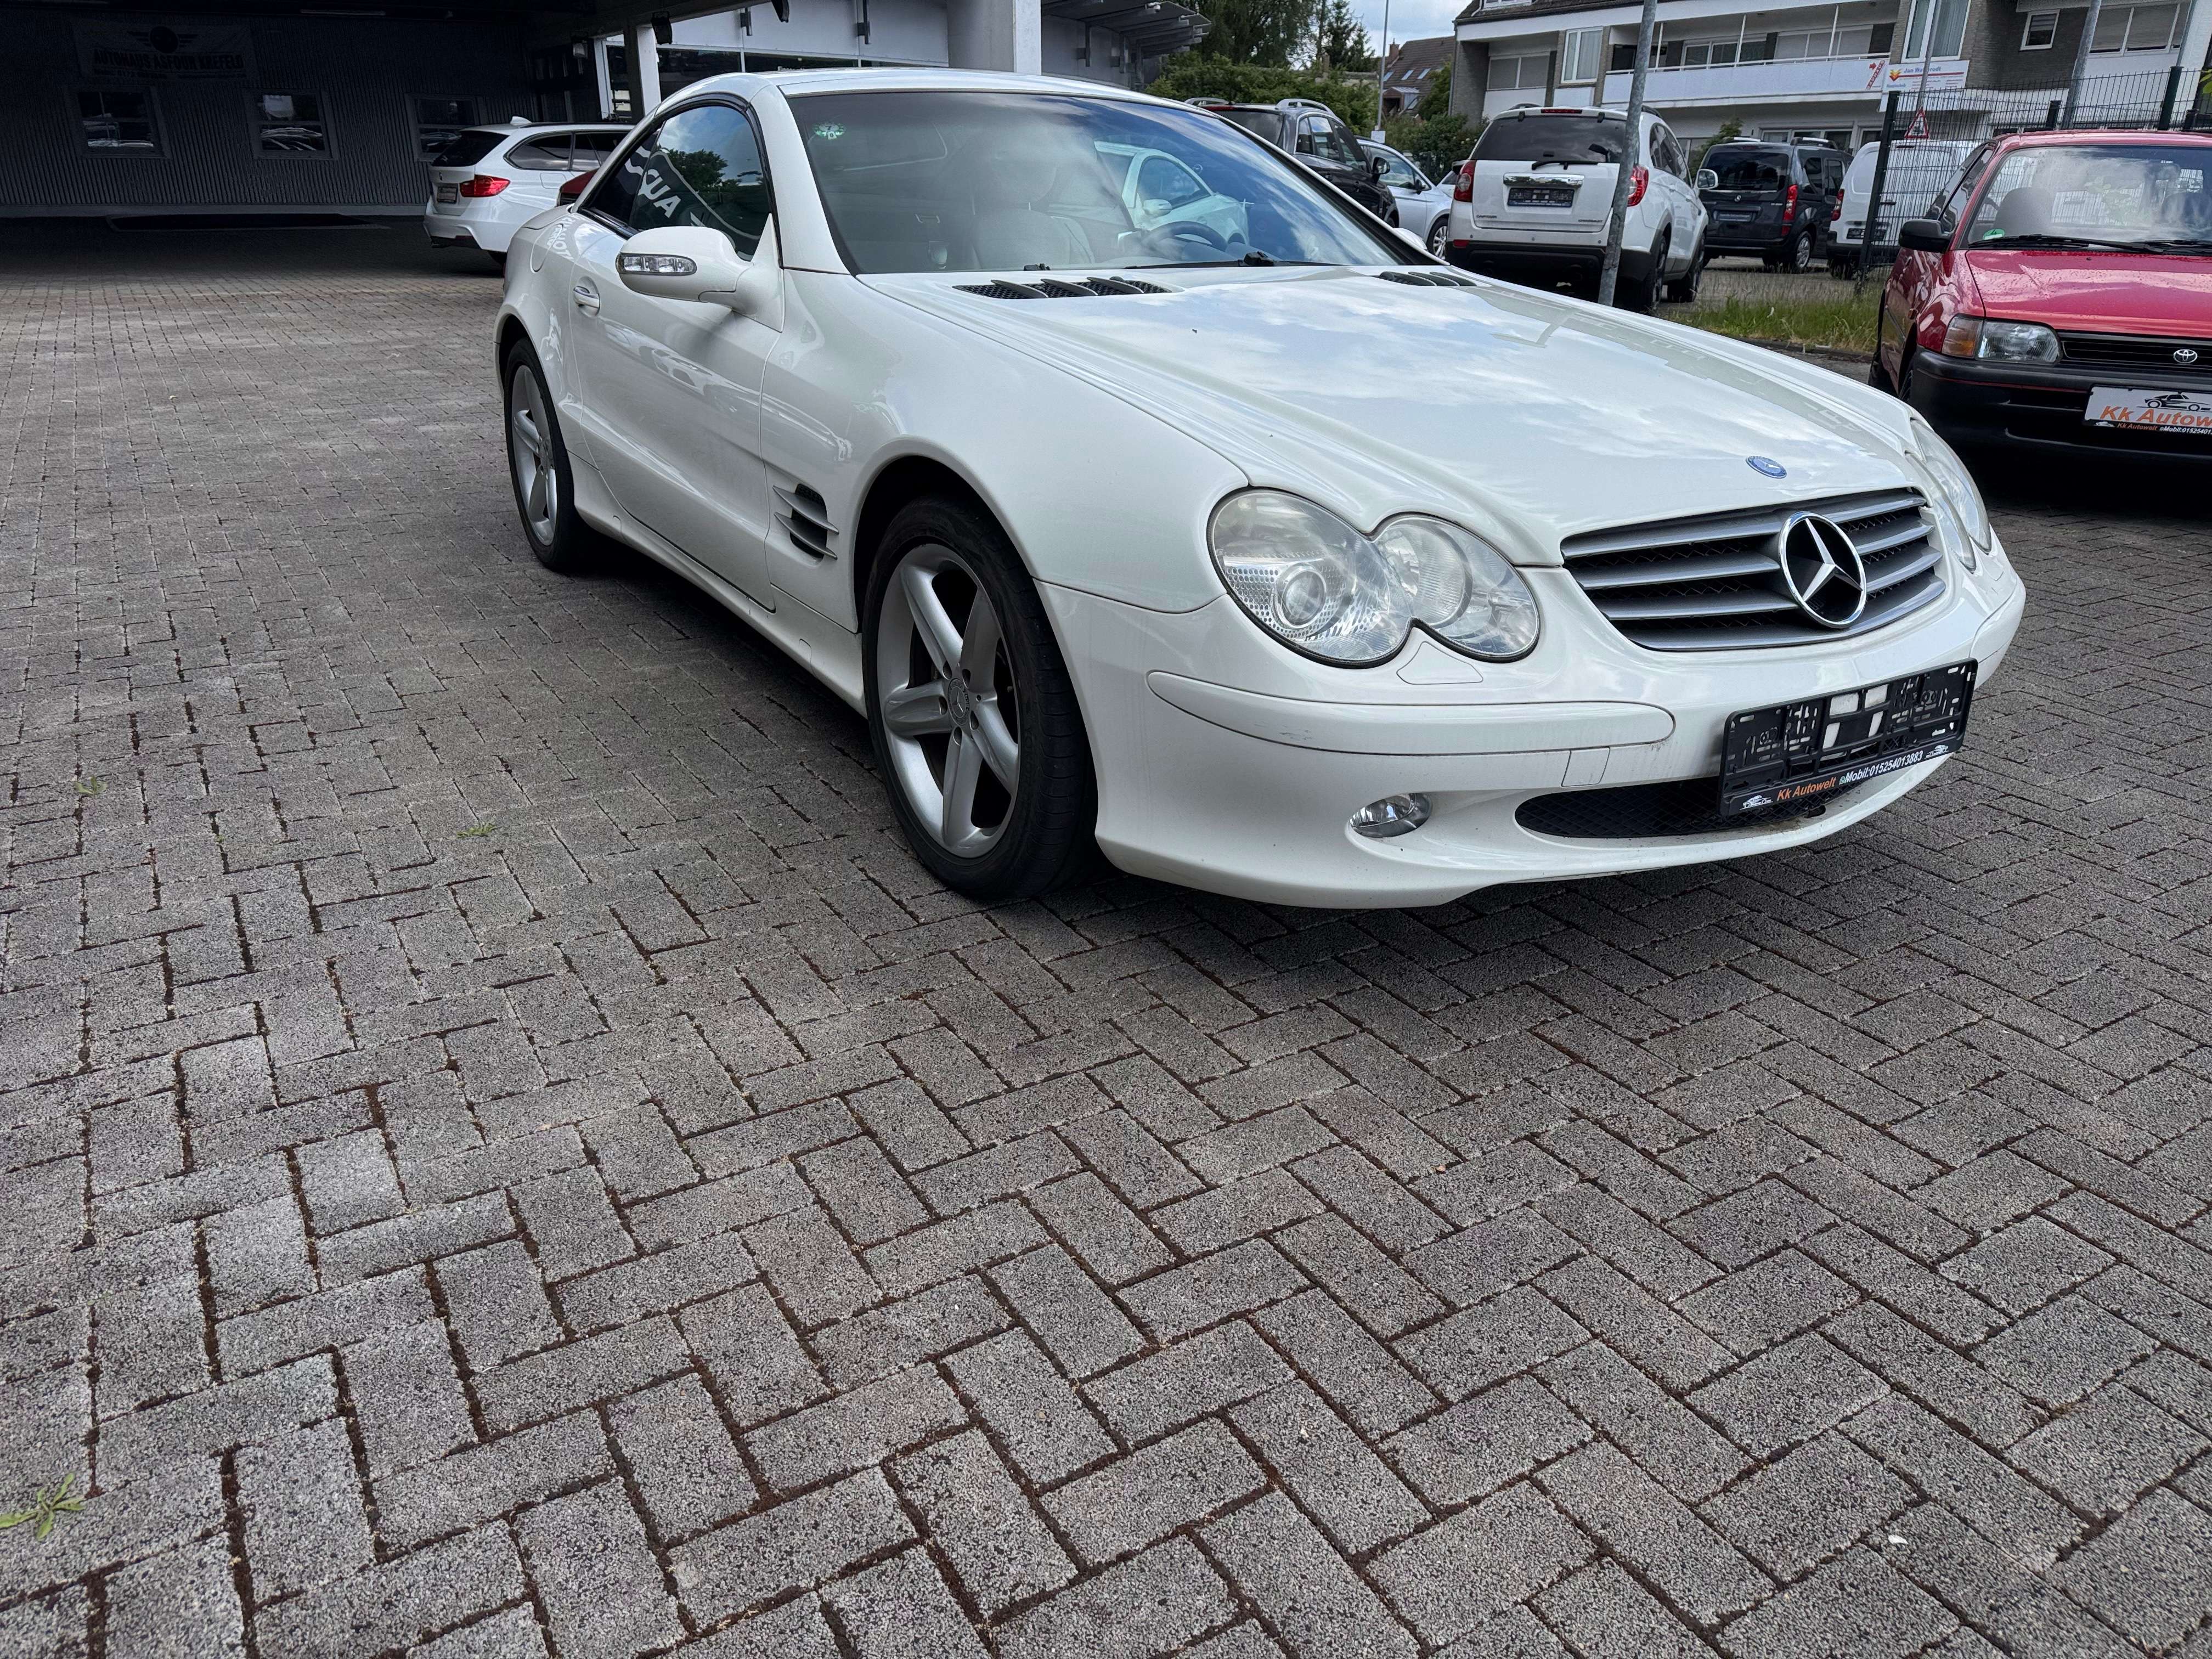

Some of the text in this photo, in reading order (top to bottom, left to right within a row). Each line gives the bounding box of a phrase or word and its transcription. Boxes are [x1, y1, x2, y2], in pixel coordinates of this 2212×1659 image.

[94, 49, 151, 69] AUTOHAUS
[199, 54, 244, 70] KREFELD
[2100, 405, 2134, 421] Kk
[1777, 786, 1792, 801] Kk
[1793, 776, 1837, 797] Autowelt
